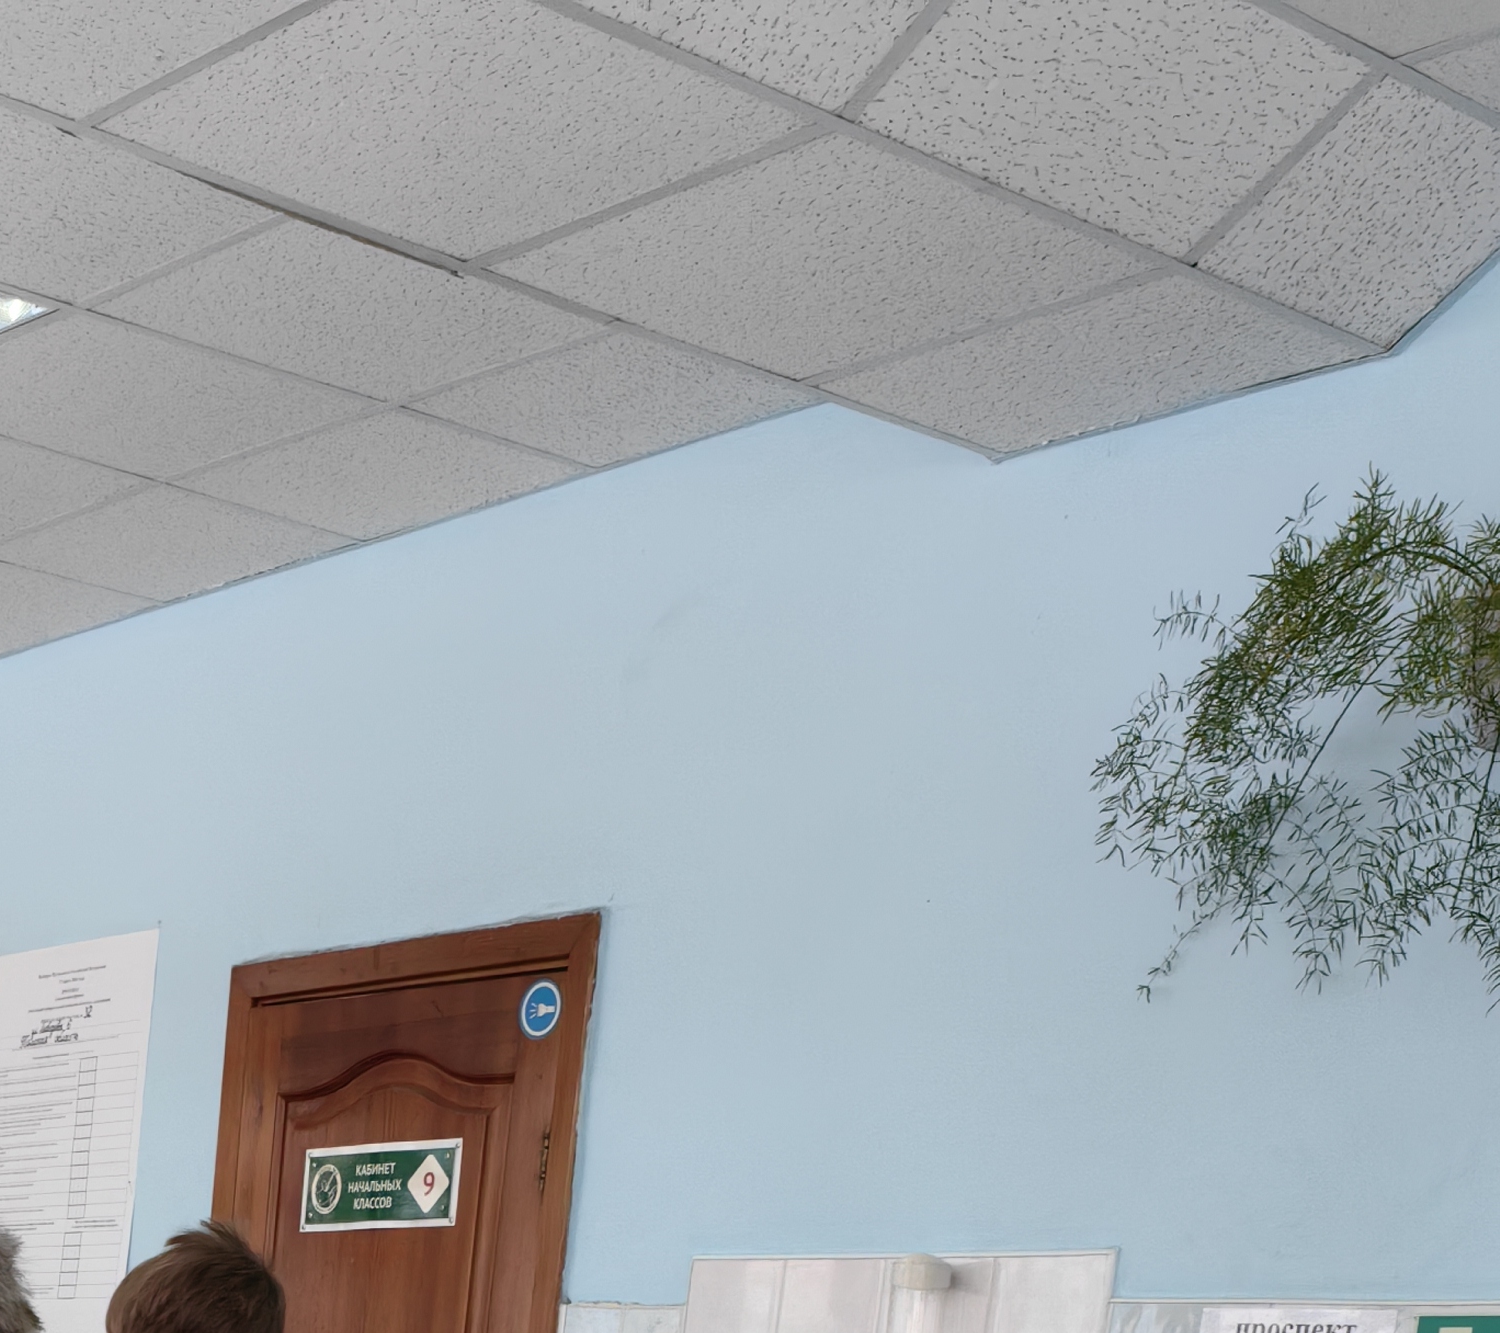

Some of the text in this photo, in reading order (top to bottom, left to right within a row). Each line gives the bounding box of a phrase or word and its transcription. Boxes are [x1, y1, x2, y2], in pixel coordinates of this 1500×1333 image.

[355, 1162, 396, 1176] КАБИНЕТ
[348, 1179, 402, 1193] НАЧАЛЬНЫХ
[423, 1171, 435, 1196] 9
[353, 1196, 392, 1210] КЛАССОВ
